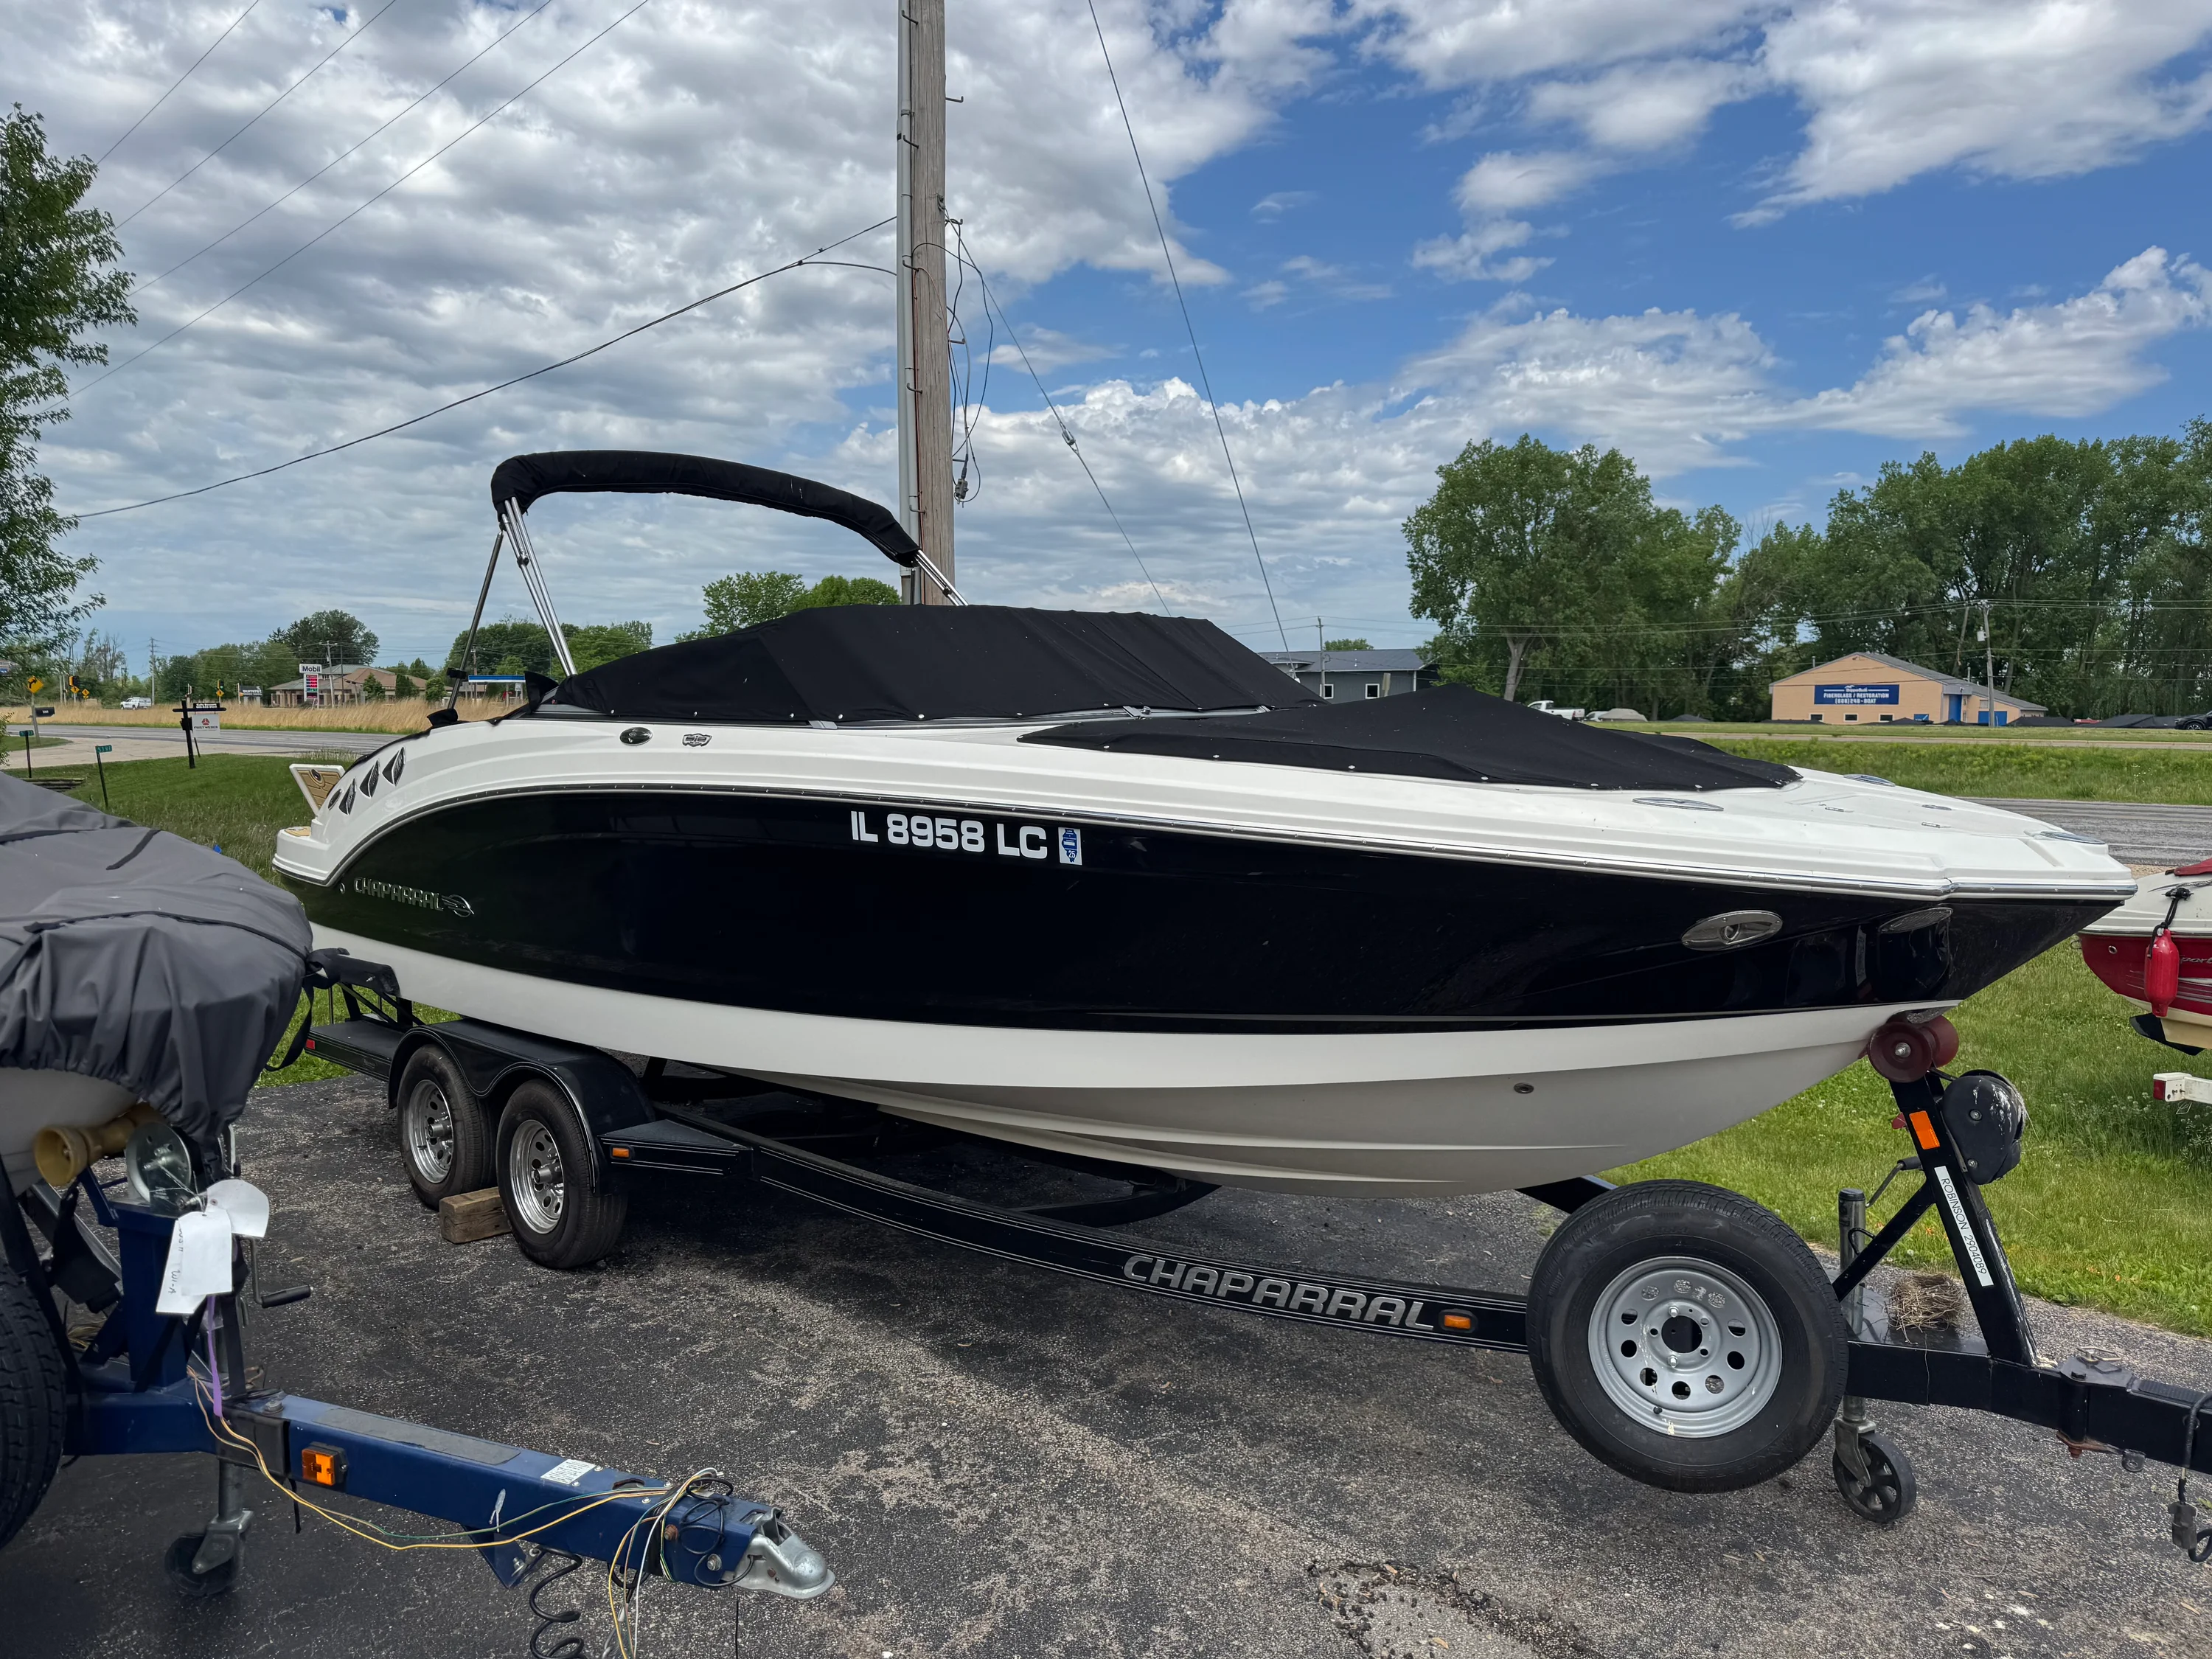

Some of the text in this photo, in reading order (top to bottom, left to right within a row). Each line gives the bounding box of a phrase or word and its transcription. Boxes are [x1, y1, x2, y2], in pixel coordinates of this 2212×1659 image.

[851, 810, 1048, 859] IL 8958 LC
[1068, 850, 1076, 858] 25
[353, 877, 444, 911] CHAPARRAL
[1941, 1178, 1987, 1274] ROBINSON 2904089
[1123, 1255, 1434, 1330] CHAPARRAL
